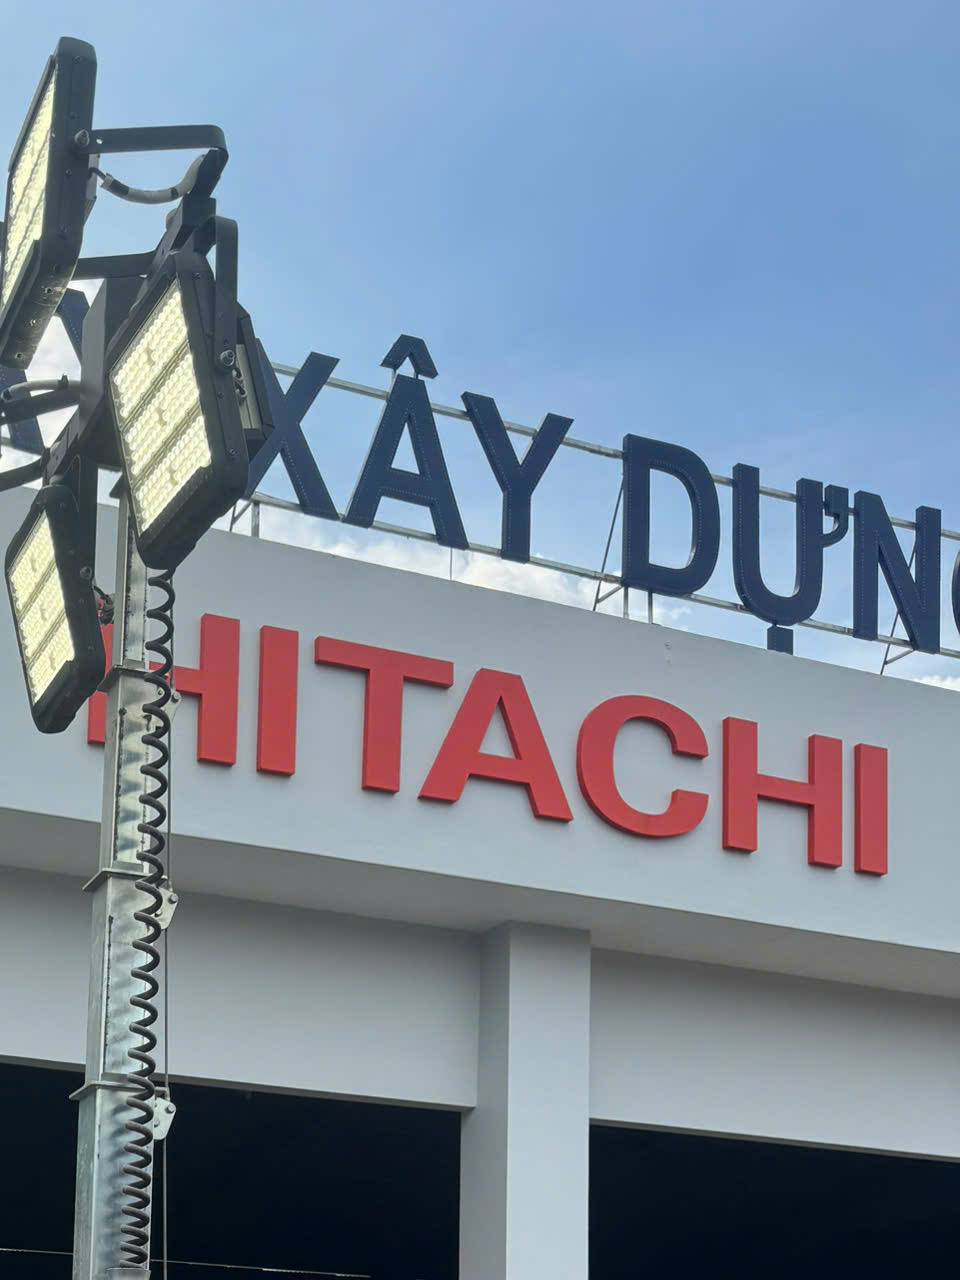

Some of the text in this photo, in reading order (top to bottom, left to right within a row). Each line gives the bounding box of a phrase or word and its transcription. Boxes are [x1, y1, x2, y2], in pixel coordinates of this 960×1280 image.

[246, 334, 575, 563] XÂY
[622, 434, 960, 655] DỰN
[87, 597, 889, 877] HITACHI
